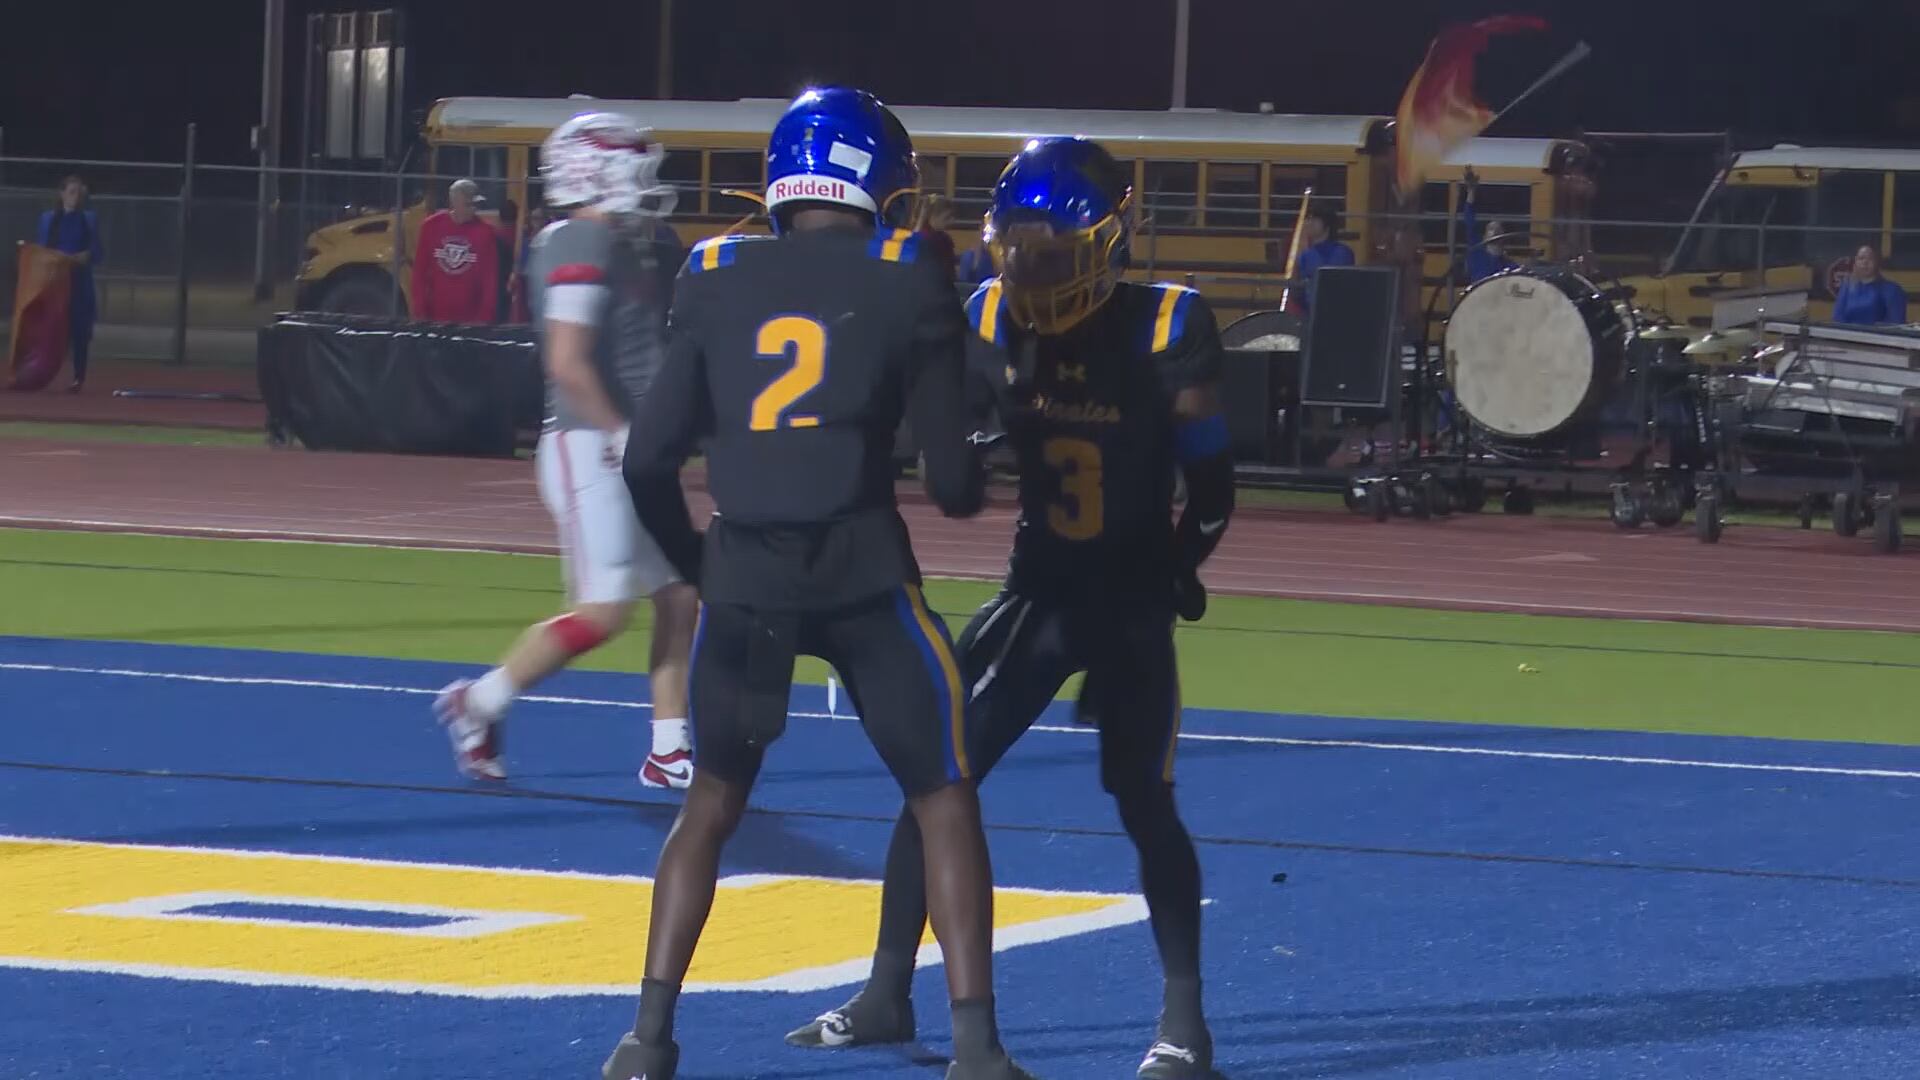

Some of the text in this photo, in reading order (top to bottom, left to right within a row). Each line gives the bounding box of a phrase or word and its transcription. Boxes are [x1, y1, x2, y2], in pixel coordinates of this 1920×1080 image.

[775, 180, 845, 200] Riddell
[748, 314, 826, 431] 2
[1044, 437, 1104, 540] 3
